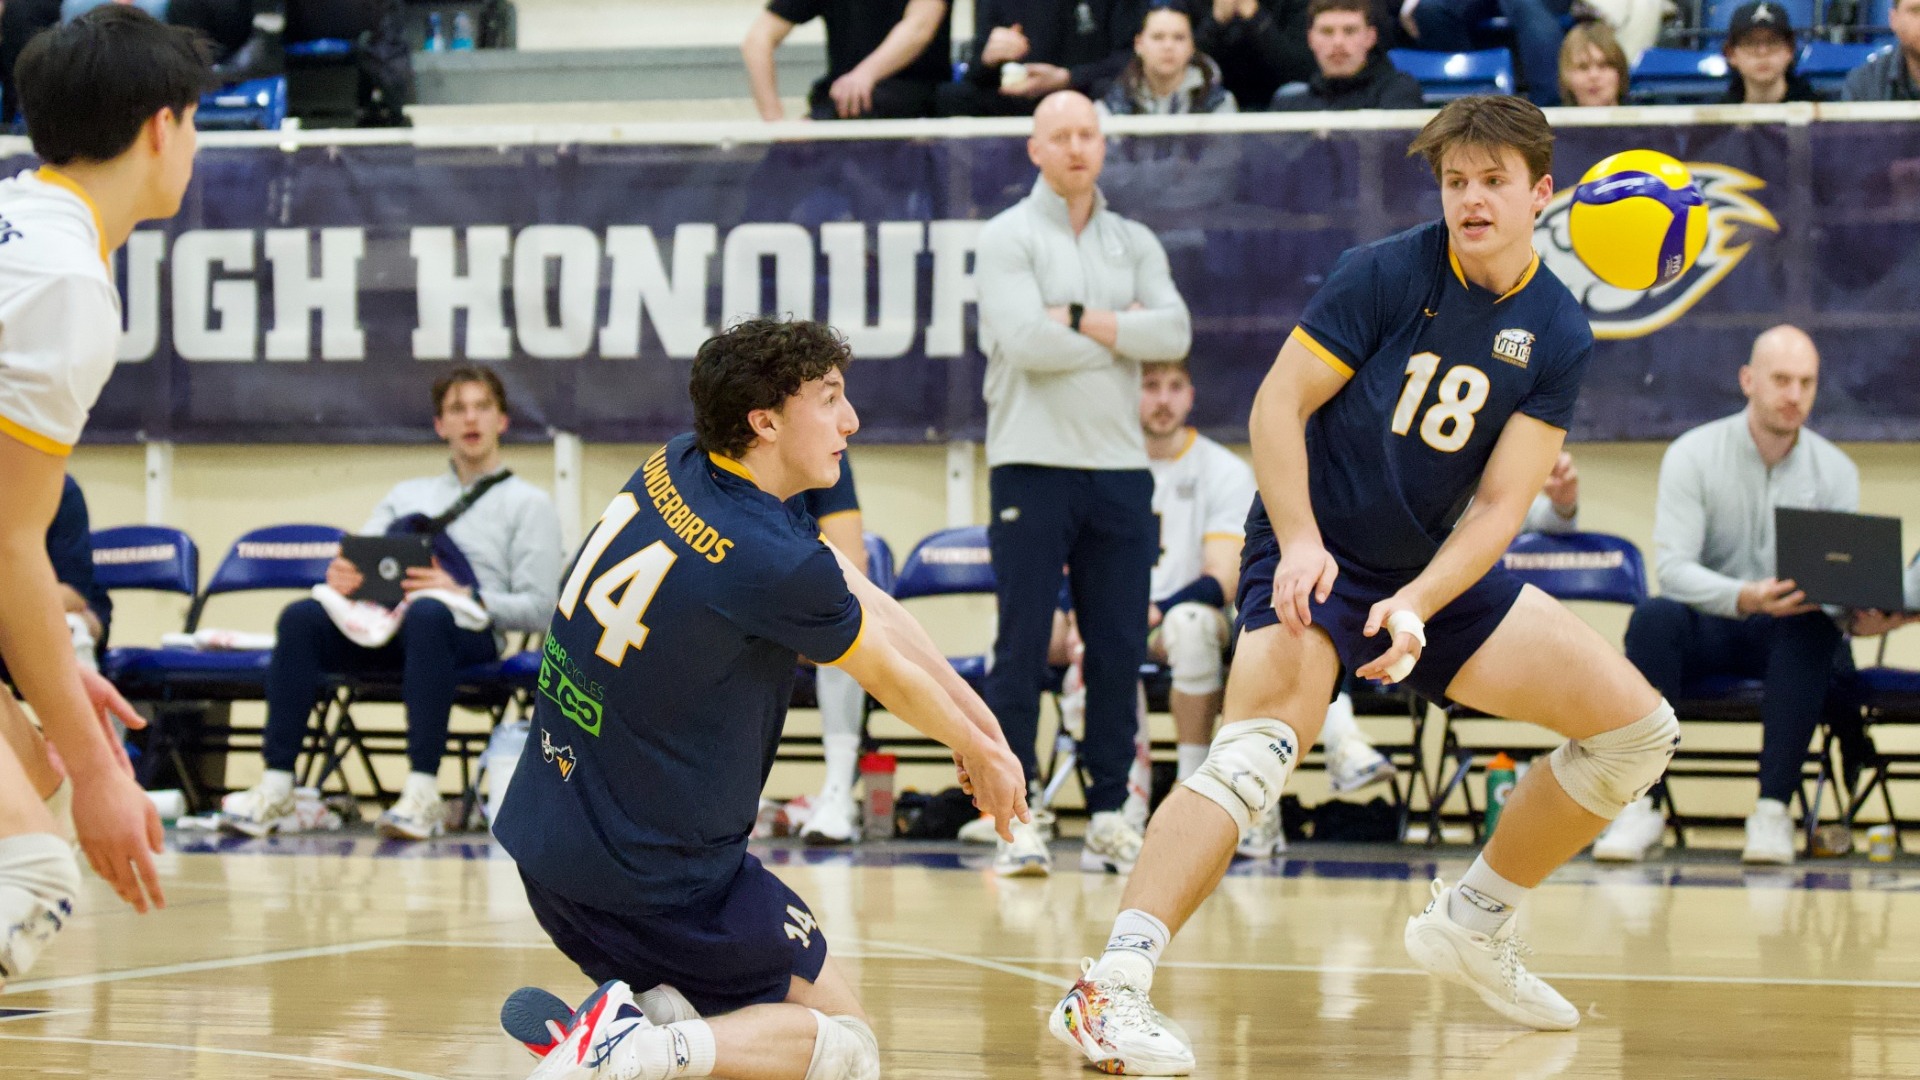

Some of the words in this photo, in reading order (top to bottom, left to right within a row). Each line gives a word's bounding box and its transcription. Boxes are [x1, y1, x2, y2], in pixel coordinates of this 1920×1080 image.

[1391, 351, 1490, 453] 18
[558, 491, 678, 668] 14
[783, 903, 818, 950] 14
